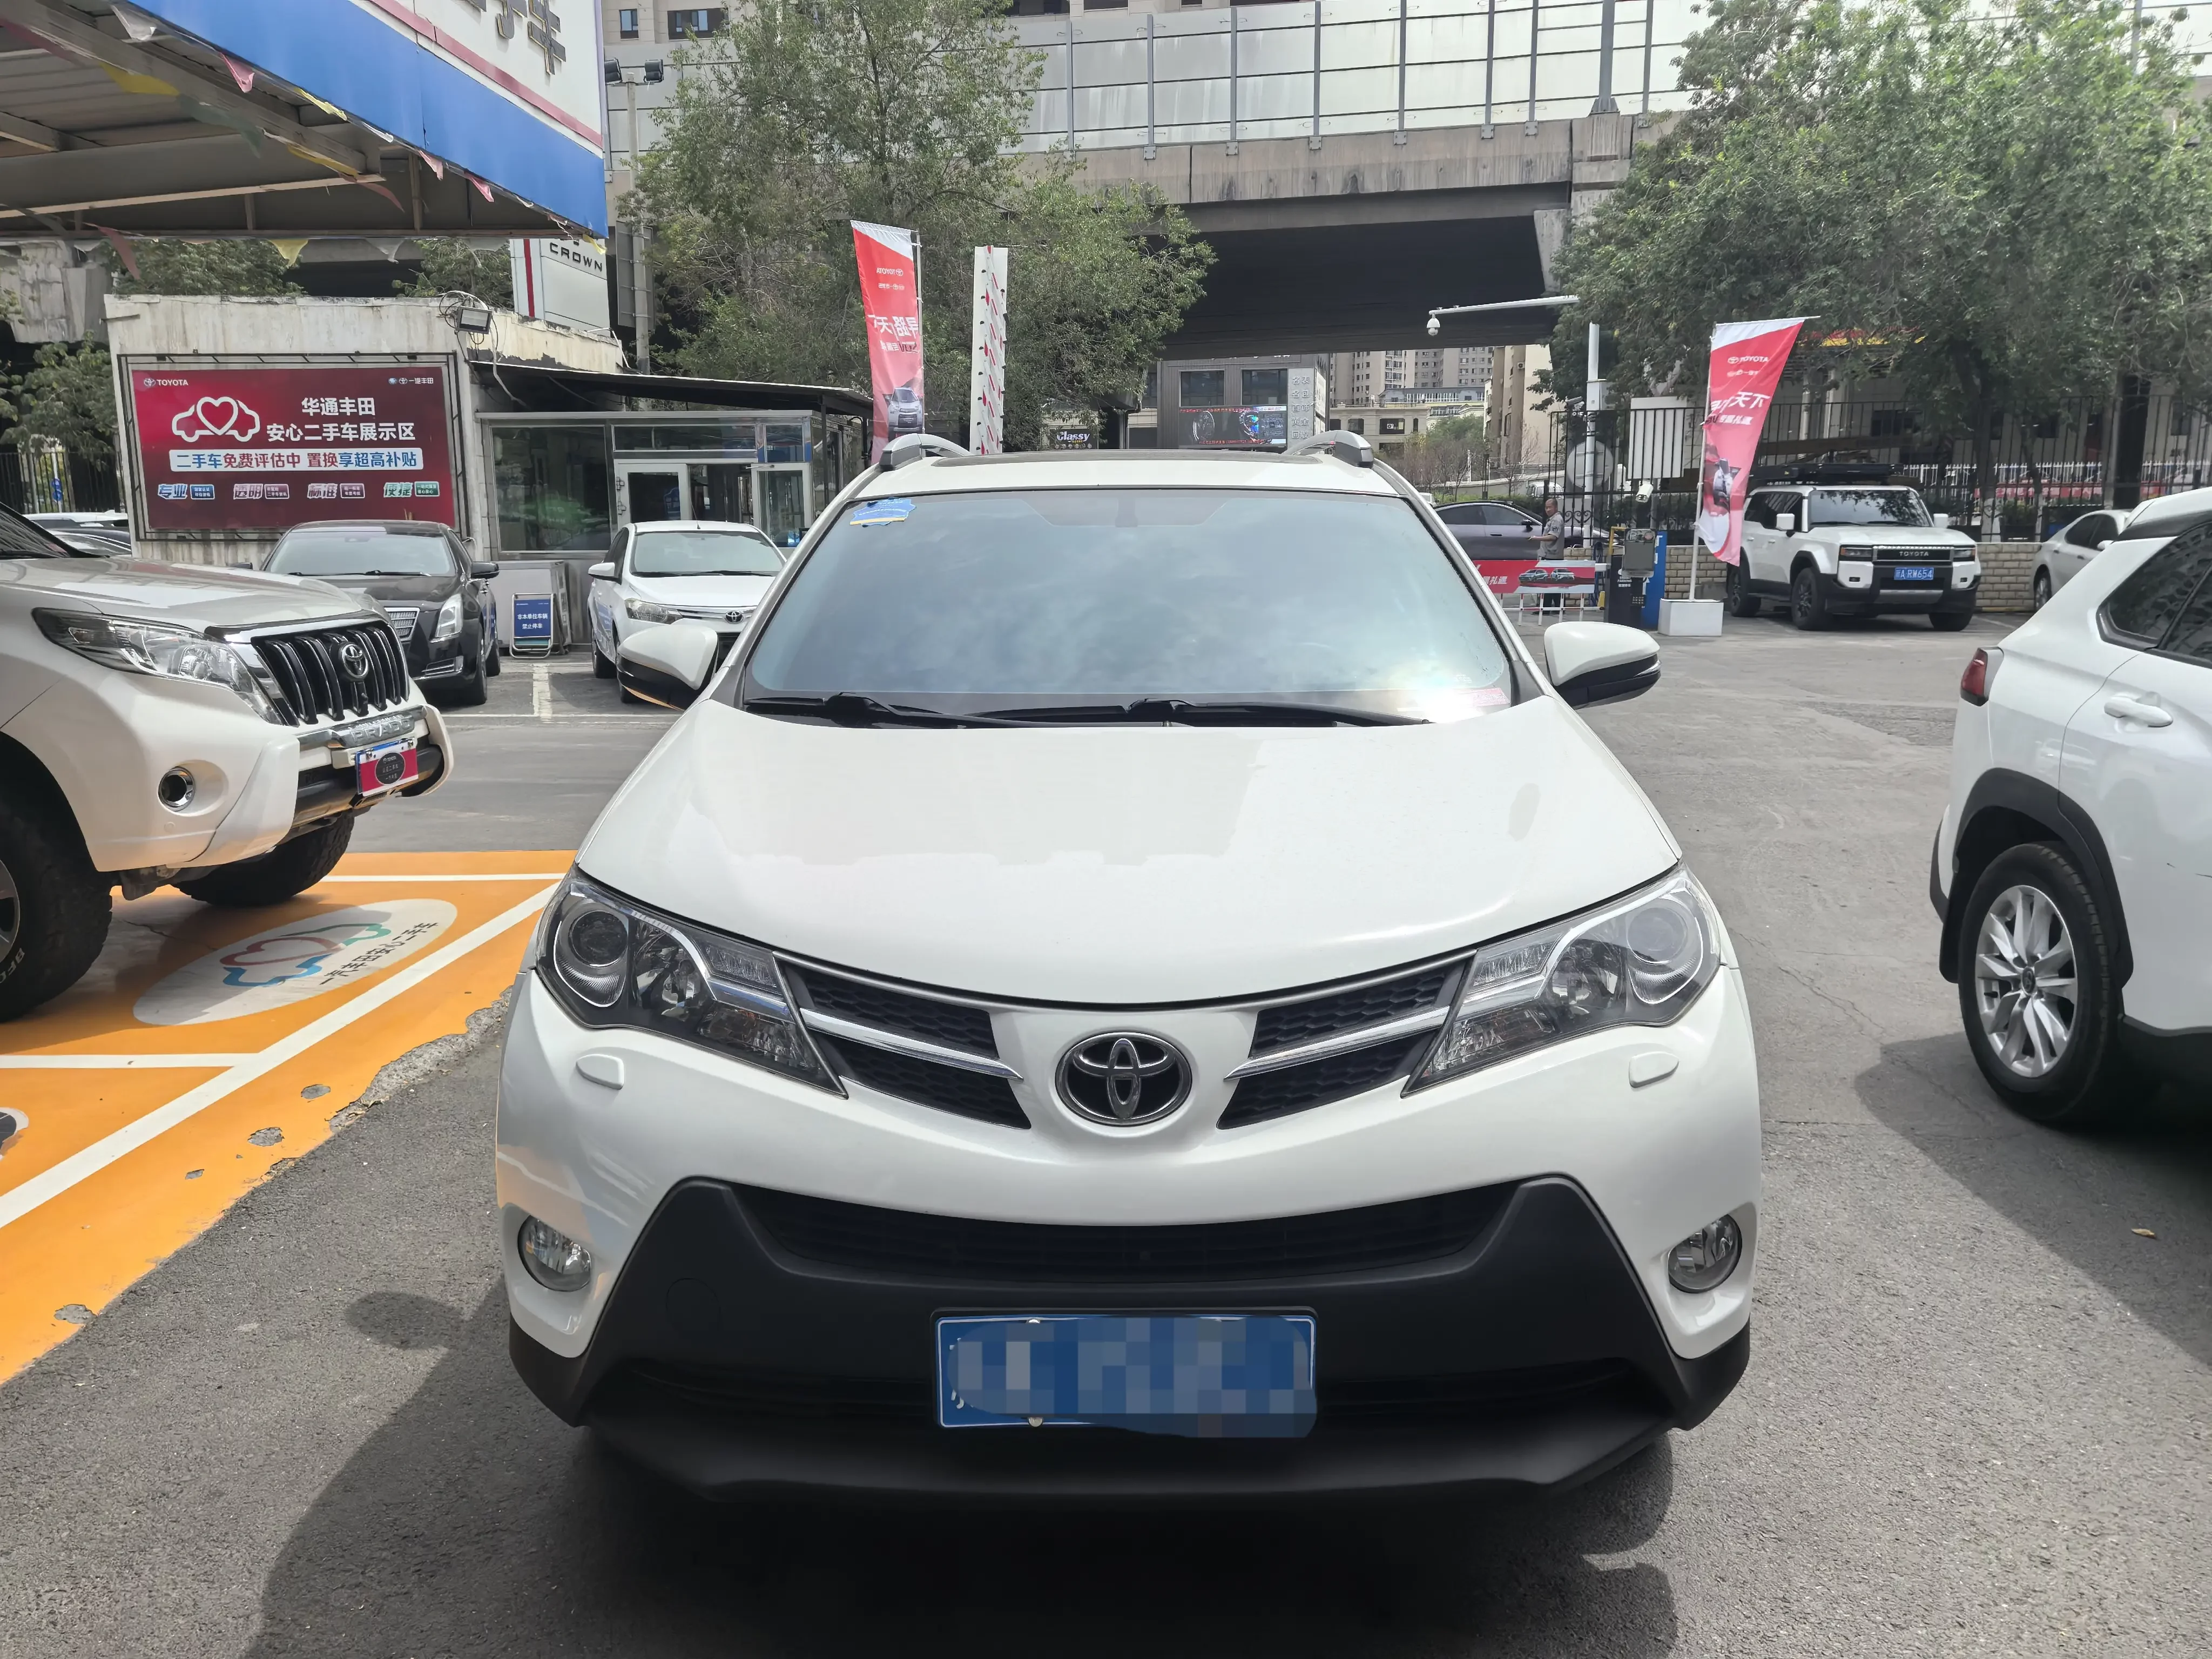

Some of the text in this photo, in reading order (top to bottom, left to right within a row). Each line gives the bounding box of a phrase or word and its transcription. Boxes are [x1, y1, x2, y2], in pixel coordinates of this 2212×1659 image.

[550, 242, 603, 272] CROWN
[1292, 376, 1310, 384] 名表
[301, 397, 376, 416] 华通丰田
[267, 422, 416, 442] 安心二手车展示区
[177, 451, 417, 469] 二手车免费评估中 置换享超高补贴
[158, 484, 188, 499] 专业
[307, 483, 338, 498] 标准
